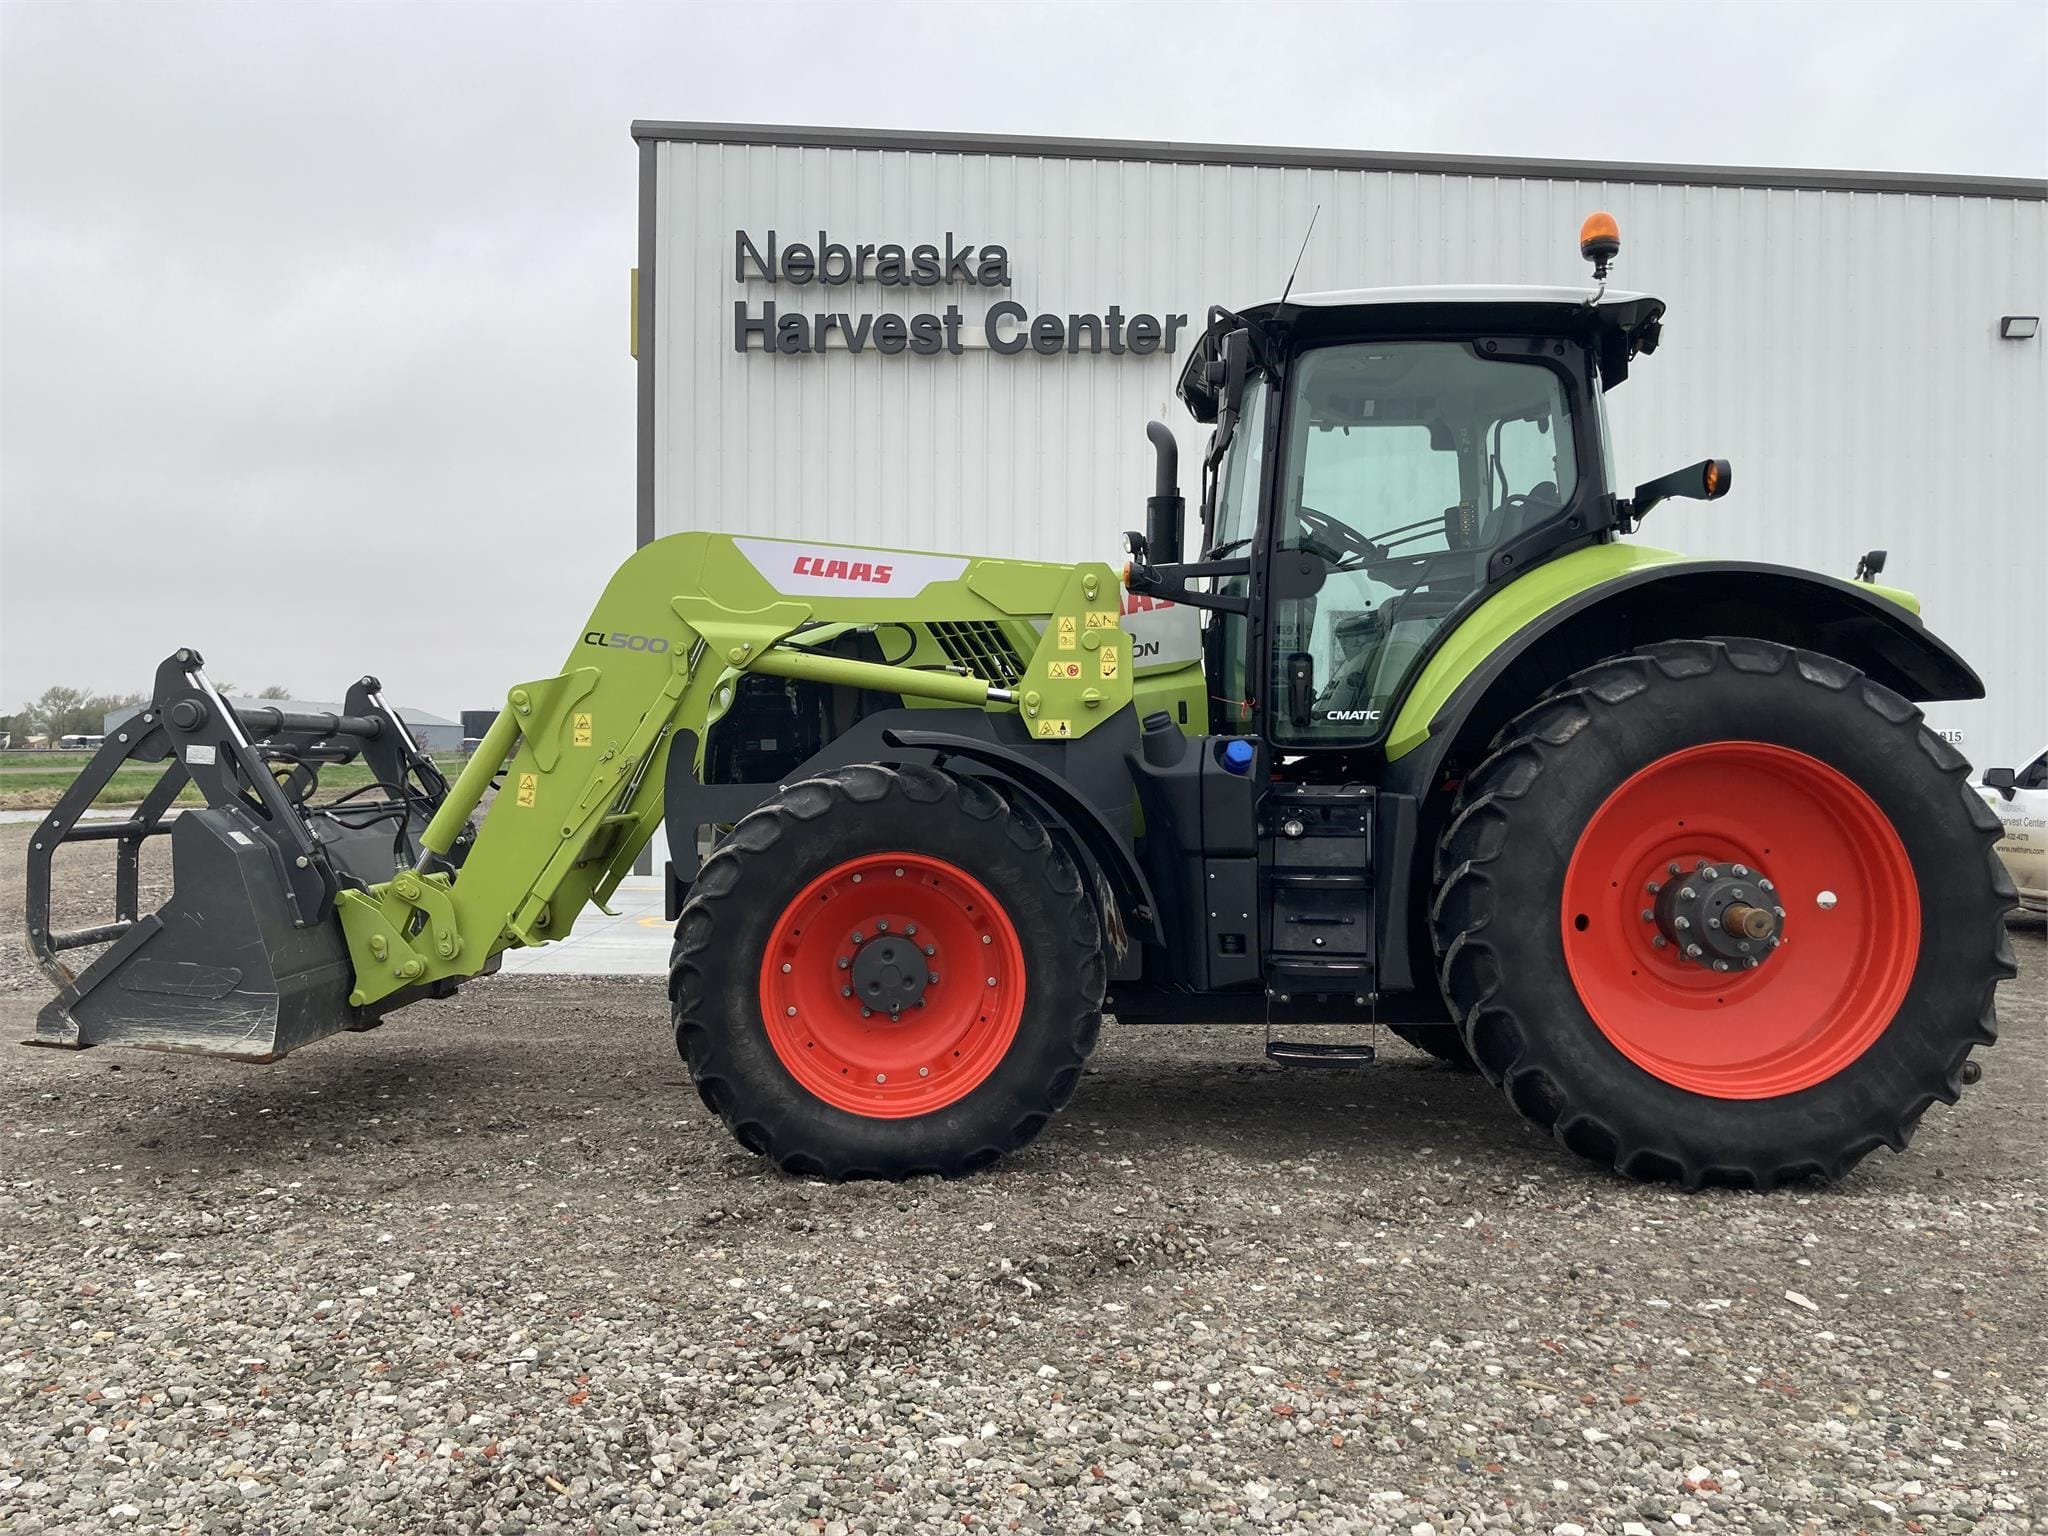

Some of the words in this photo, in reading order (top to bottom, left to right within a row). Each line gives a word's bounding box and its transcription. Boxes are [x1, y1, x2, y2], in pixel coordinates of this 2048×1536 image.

[735, 230, 1012, 287] Nebraska
[734, 301, 963, 355] Harvest
[985, 301, 1187, 355] Center
[793, 556, 893, 584] CLAAS
[584, 631, 669, 654] CL500
[1326, 710, 1381, 720] CMATIC
[2024, 817, 2046, 828] Center
